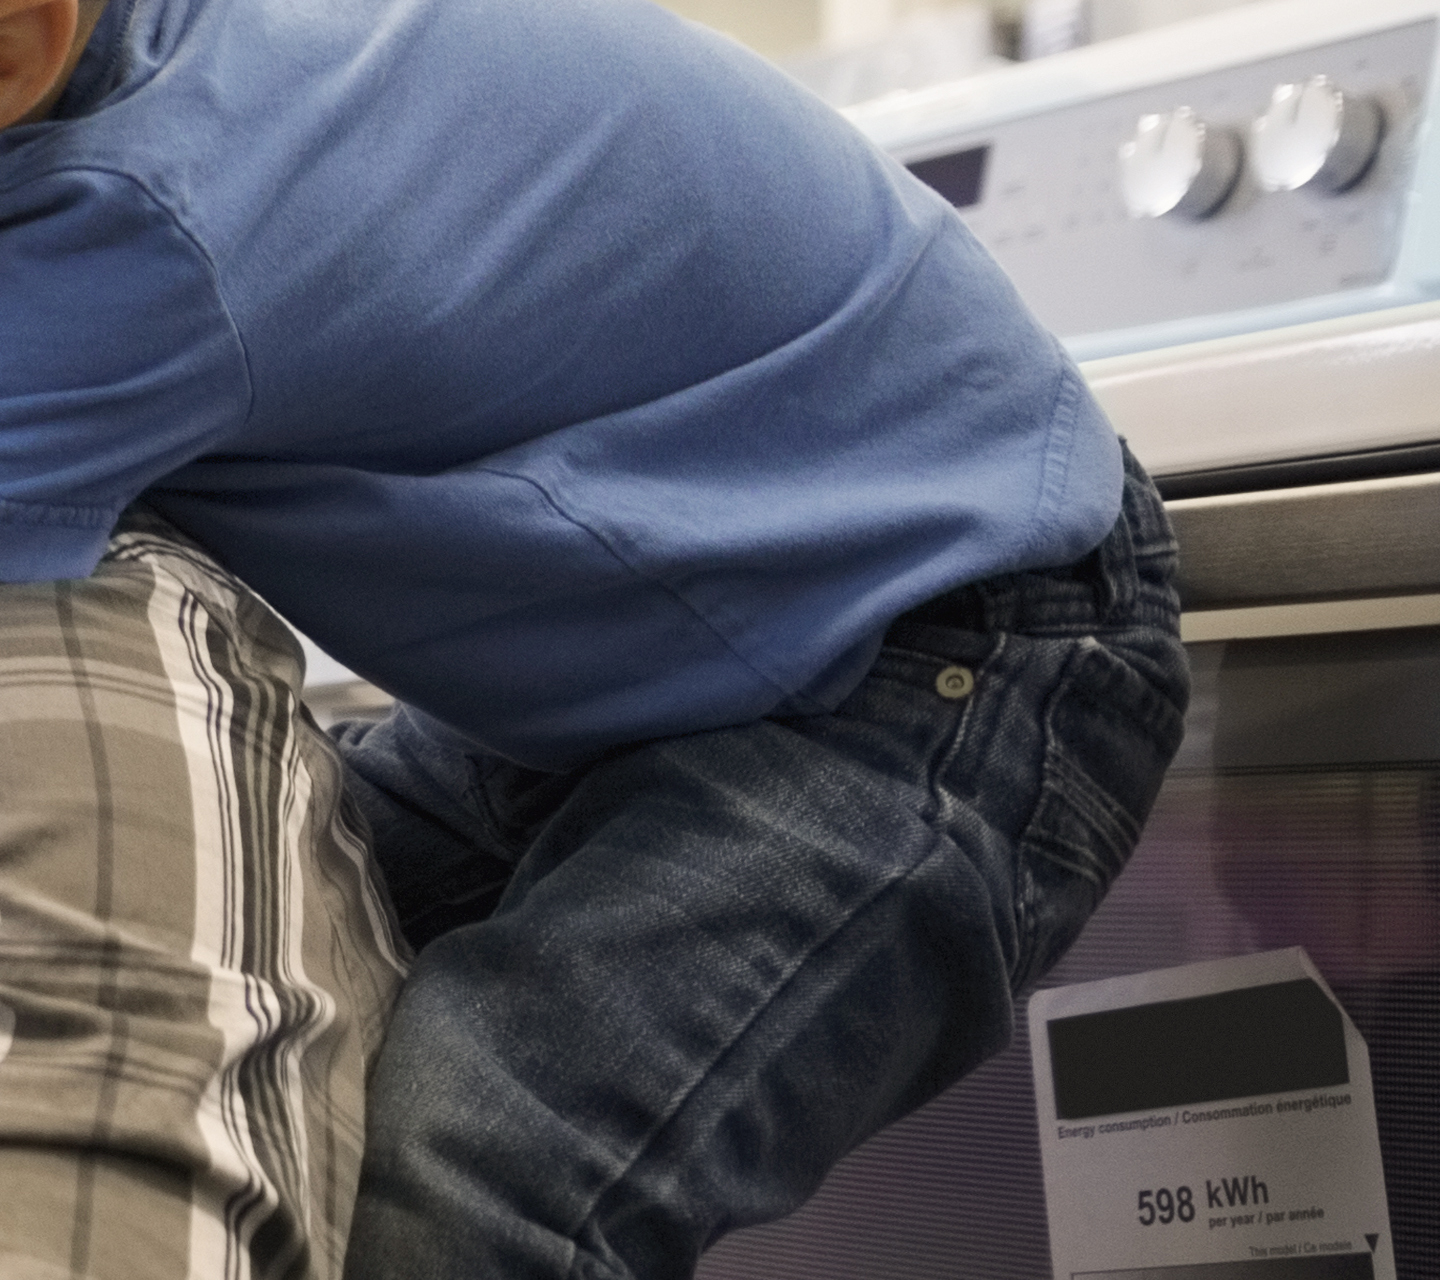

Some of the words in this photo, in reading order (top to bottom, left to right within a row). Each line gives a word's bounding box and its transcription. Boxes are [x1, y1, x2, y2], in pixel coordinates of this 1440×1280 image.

[1058, 1125, 1095, 1140] Energy
[1098, 1115, 1172, 1133] consumption
[1182, 1101, 1273, 1124] Consommation
[1276, 1093, 1352, 1113] énergétique
[1137, 1185, 1196, 1226] 598
[1206, 1175, 1269, 1208] kWh
[1209, 1216, 1227, 1230] per
[1231, 1213, 1255, 1229] year
[1266, 1211, 1285, 1225] par
[1288, 1205, 1325, 1222] année
